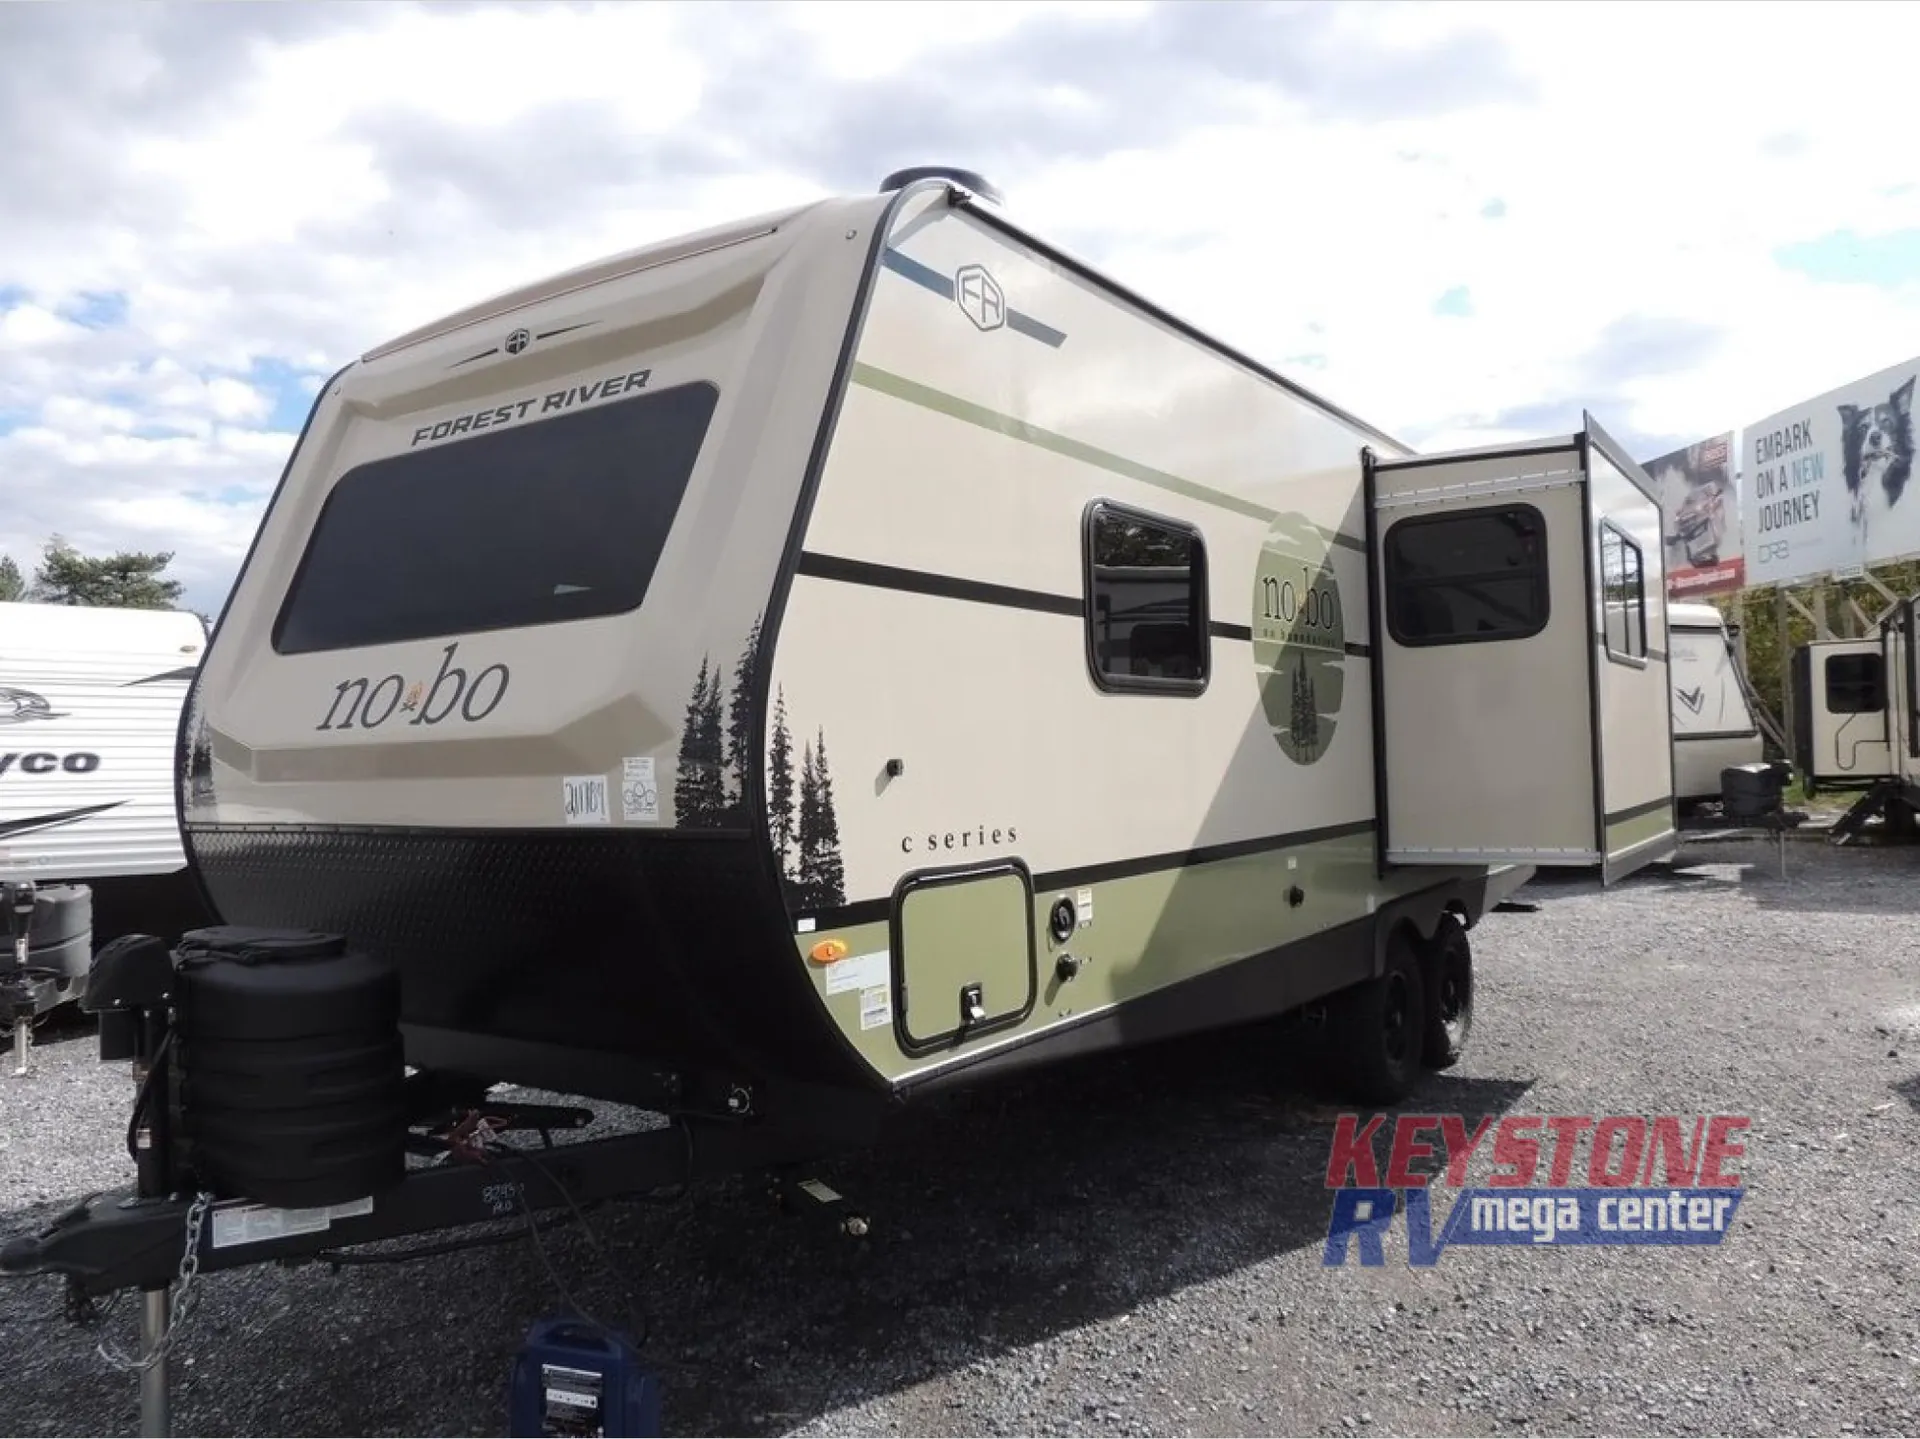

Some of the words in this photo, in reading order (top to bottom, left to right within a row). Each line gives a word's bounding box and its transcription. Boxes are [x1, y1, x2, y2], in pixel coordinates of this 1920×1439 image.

[411, 398, 537, 446] FOREST
[541, 369, 652, 413] RIVER
[1756, 417, 1812, 465] EMBARK
[1757, 468, 1775, 499] ON
[1780, 465, 1788, 492] A
[1792, 451, 1824, 488] NEW
[1758, 489, 1820, 534] JOURNEY
[901, 836, 913, 854] c
[927, 824, 1017, 851] series
